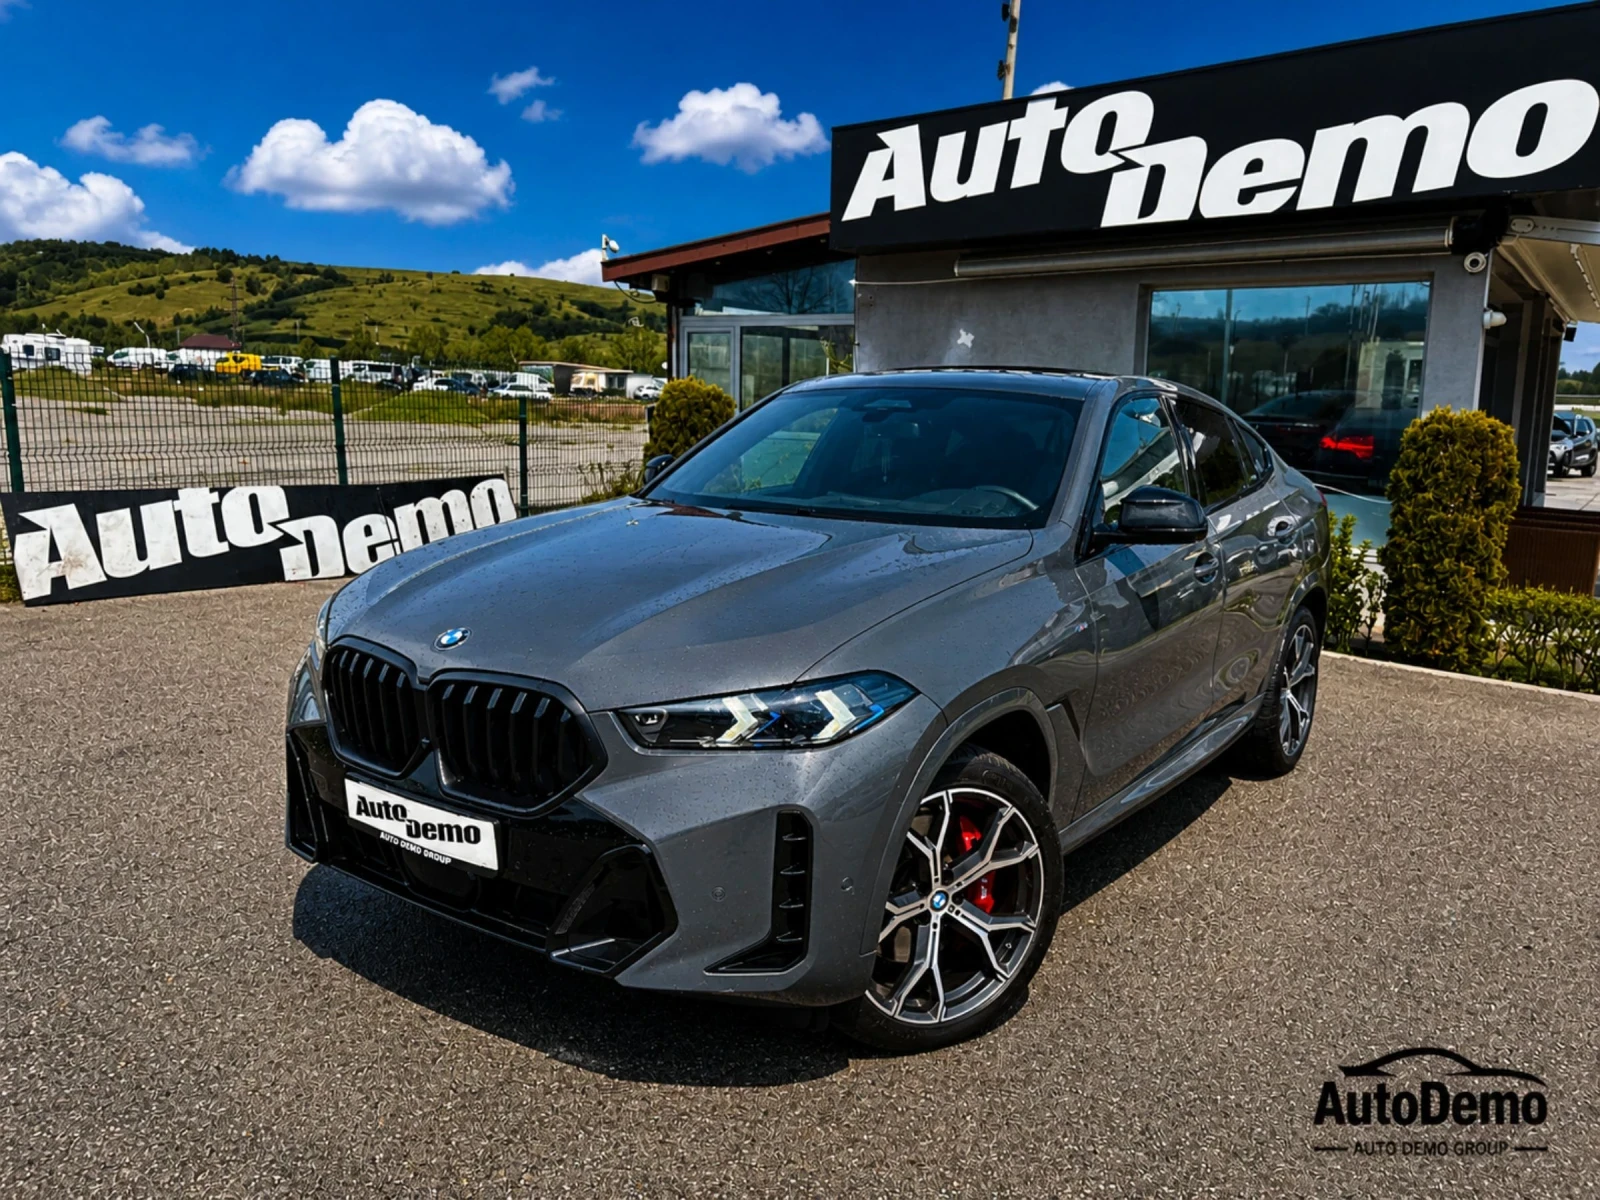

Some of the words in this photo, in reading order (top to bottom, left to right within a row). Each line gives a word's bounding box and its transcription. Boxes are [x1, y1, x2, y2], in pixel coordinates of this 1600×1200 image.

[380, 831, 399, 845] AUTO
[400, 840, 422, 855] DEMO
[423, 850, 452, 865] GROUP
